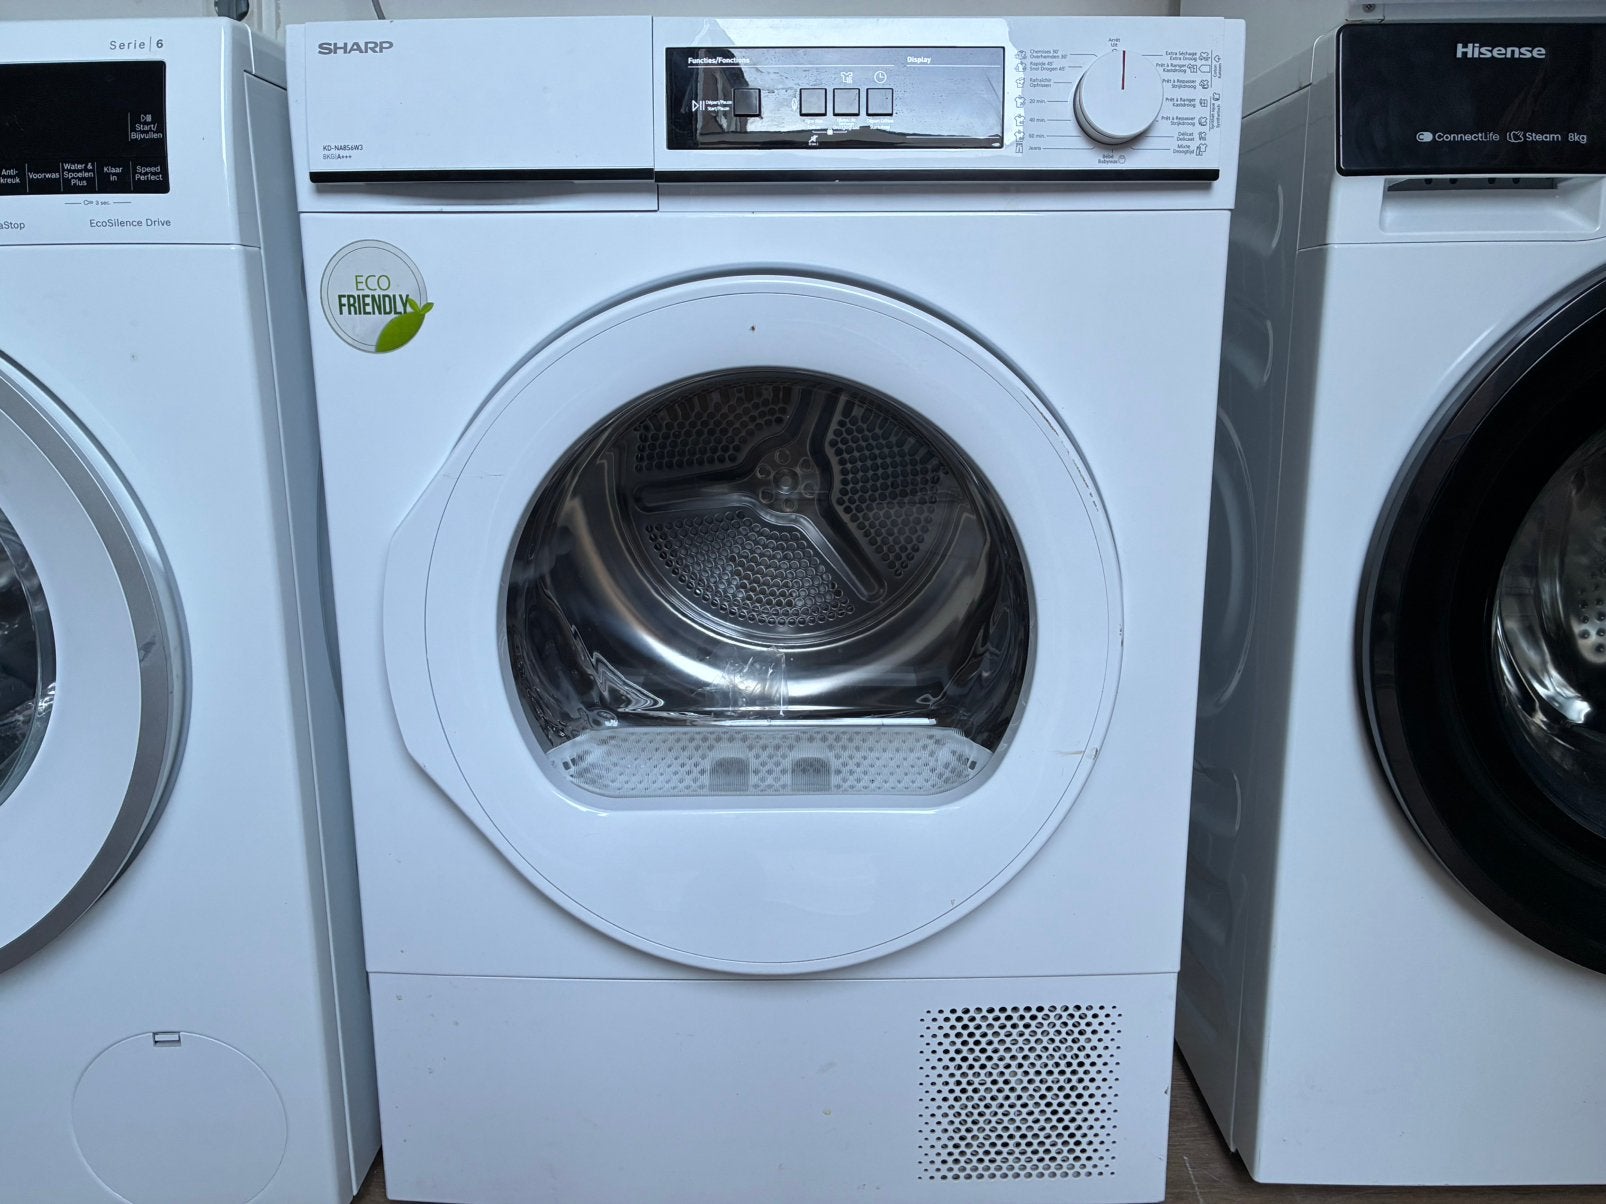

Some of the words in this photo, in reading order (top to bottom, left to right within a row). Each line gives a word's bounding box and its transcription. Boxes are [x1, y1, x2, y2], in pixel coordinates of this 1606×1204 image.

[109, 40, 146, 50] Serie
[156, 39, 164, 49] 6
[318, 41, 394, 55] SHARP
[1456, 43, 1546, 59] Hisense
[907, 56, 931, 64] Display
[135, 123, 158, 132] Start/
[130, 131, 163, 141] Bijvullen
[1435, 131, 1500, 142] ConnectLife
[1525, 131, 1561, 142] Steam
[1568, 132, 1587, 144] 8kg
[63, 162, 85, 170] Water
[136, 165, 161, 174] Speed
[1, 168, 18, 176] Anti-
[28, 171, 60, 179] Voorwas
[63, 171, 94, 179] Spoelen
[135, 173, 163, 181] Perfect
[89, 218, 143, 228] EcoSilence
[145, 218, 171, 227] Drive
[355, 274, 391, 291] ECO
[337, 294, 410, 315] FRIENDLY
